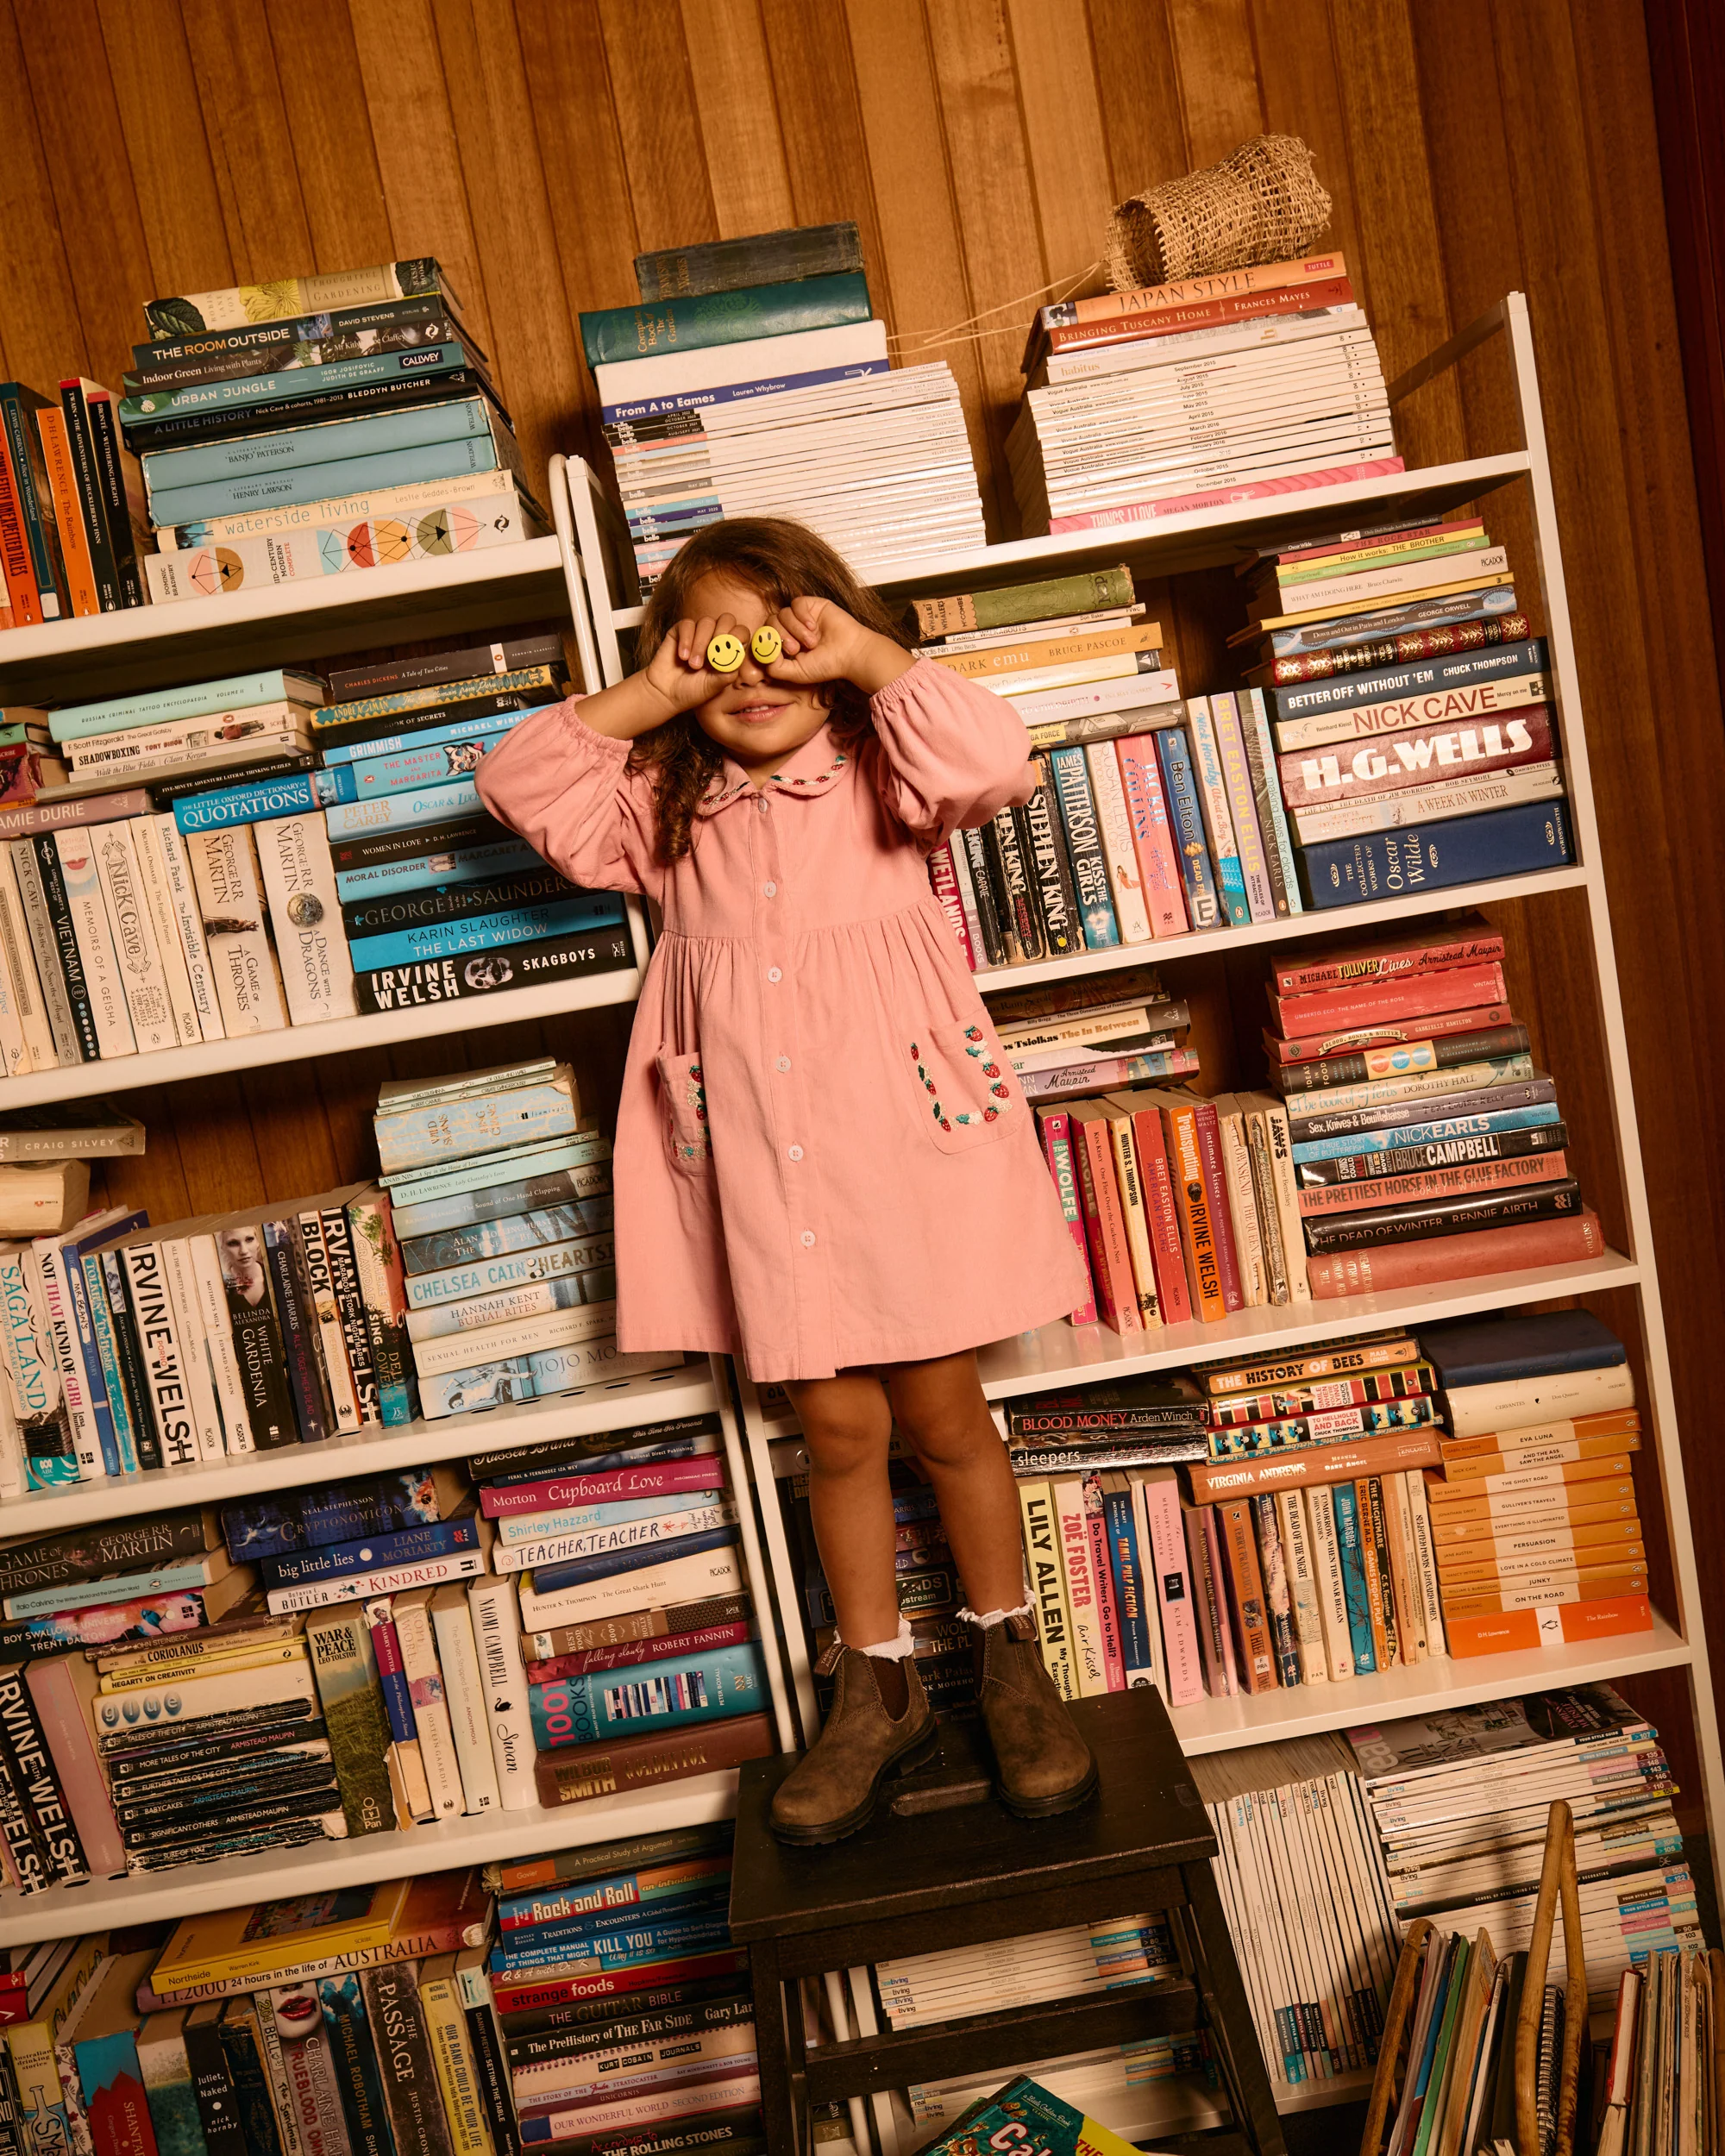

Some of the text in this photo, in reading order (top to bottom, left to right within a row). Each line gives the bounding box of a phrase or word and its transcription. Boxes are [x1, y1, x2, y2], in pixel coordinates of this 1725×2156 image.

[1308, 261, 1331, 272] TUTTLE
[1120, 272, 1256, 313] JAPAN STYLE
[1059, 307, 1211, 343] BRINGING TUSCANY HOME
[153, 329, 290, 360] THE ROOM OUTSIDE
[142, 358, 262, 384] Indoor Green Living with Plants
[403, 353, 439, 367] CALLWEY
[1175, 363, 1201, 372] September
[172, 380, 276, 406] URBAN JUNGLE
[348, 379, 430, 399] BLEDDYN BUTCHER
[732, 381, 786, 397] Lauren Whybrow
[616, 393, 715, 418] From A to Eames
[225, 499, 369, 535] waterside living
[639, 516, 656, 524] belle
[643, 533, 660, 542] belle
[1391, 536, 1445, 552] THE BROTHER
[1481, 555, 1504, 567] PICADOR
[993, 652, 1030, 667] emu
[1048, 636, 1126, 657] BRUCE PASCOE
[1443, 654, 1518, 677] CHUCK THOMPSON
[1288, 690, 1331, 709] BETTER
[1333, 686, 1354, 699] OFF
[1358, 674, 1410, 695] WITHOUT
[1352, 686, 1497, 733] NICK CAVE
[78, 745, 141, 766] SHADOWBOXING
[350, 736, 403, 758] GRIMMISH
[254, 783, 300, 800] DICTIONARY
[1217, 699, 1261, 872] BRET EASTON ELLIS
[184, 788, 310, 827] QUOTATIONS
[1059, 768, 1099, 854] PATTERSON
[1170, 761, 1196, 841] Ben Elton
[204, 837, 230, 905] MARTIN
[277, 824, 300, 893] MARTIN
[1385, 838, 1403, 890] Oscar
[1404, 834, 1425, 885] Wilde
[407, 908, 549, 943] KARIN SLAUGHTER
[56, 915, 81, 981] VIETNAM
[413, 923, 548, 957] THE LAST WIDOW
[83, 901, 101, 950] MEMOIRS
[95, 956, 104, 969] OF
[101, 987, 113, 1027] GEISHA
[298, 930, 321, 1000] DRAGONS
[522, 948, 596, 971] SKAGBOYS
[1419, 943, 1502, 967] Armistead Maupin
[227, 944, 250, 1012] THRONES
[371, 960, 455, 992] IRVINE
[1299, 958, 1414, 984] MICHAEL TOLLIVER Lives
[374, 979, 460, 1010] WELSH
[1013, 1031, 1058, 1052] Tsiolkas
[25, 1138, 115, 1150] CRAIG SILVEY
[1176, 1112, 1201, 1181] Trainspotting
[1396, 1136, 1498, 1171] BRUCE CAMPBELL
[303, 1222, 331, 1294] BLOCK
[413, 1261, 526, 1301] CHELSEA CAIN
[450, 1291, 541, 1319] HANNAH KENT
[427, 1332, 540, 1362] SEXUAL HEALTH FOR MEN
[242, 1328, 268, 1407] GARDENIA
[1216, 1375, 1242, 1389] THE
[1245, 1363, 1305, 1384] HISTORY
[1308, 1360, 1328, 1374] OF
[65, 1376, 84, 1411] GIRL
[1022, 1413, 1128, 1432] BLOOD MONEY
[1017, 1448, 1082, 1467] sleepers
[492, 1472, 664, 1507] Morton Cupboard Love
[1207, 1463, 1307, 1490] VIRGINIA ANDREWS
[1514, 1539, 1556, 1549] PERSUASION
[278, 1551, 354, 1579] big little lies
[369, 1564, 448, 1592] KINDRED
[1026, 1499, 1066, 1645] LILY ALLEN
[1066, 1545, 1092, 1608] FOSTER
[316, 1639, 355, 1658] PEACE
[331, 1650, 357, 1662] TOLSTOY
[484, 1635, 508, 1688] CAMPBELL
[111, 1678, 143, 1689] HEGARTY
[157, 1668, 196, 1680] CREATIVITY
[541, 1679, 576, 1747] 1001
[569, 1677, 594, 1743] BOOKS
[231, 1730, 295, 1749] ARMISTEAD MAUPIN
[496, 1724, 519, 1773] Swan
[160, 1756, 181, 1764] TALES
[205, 1747, 221, 1756] CITY
[365, 1820, 381, 1829] Pan
[531, 1882, 635, 1921] Rock and Roll
[593, 1932, 653, 1954] KILL YOU
[231, 1935, 438, 1988] 24 hours in the life of AUSTRALIA
[511, 1979, 615, 2007] strange foods
[377, 1983, 415, 2082] PASSAGE
[599, 2043, 701, 2071] KURT COBAIN JOURNALS
[198, 2072, 224, 2085] Juliet,
[200, 2084, 228, 2097] Naked
